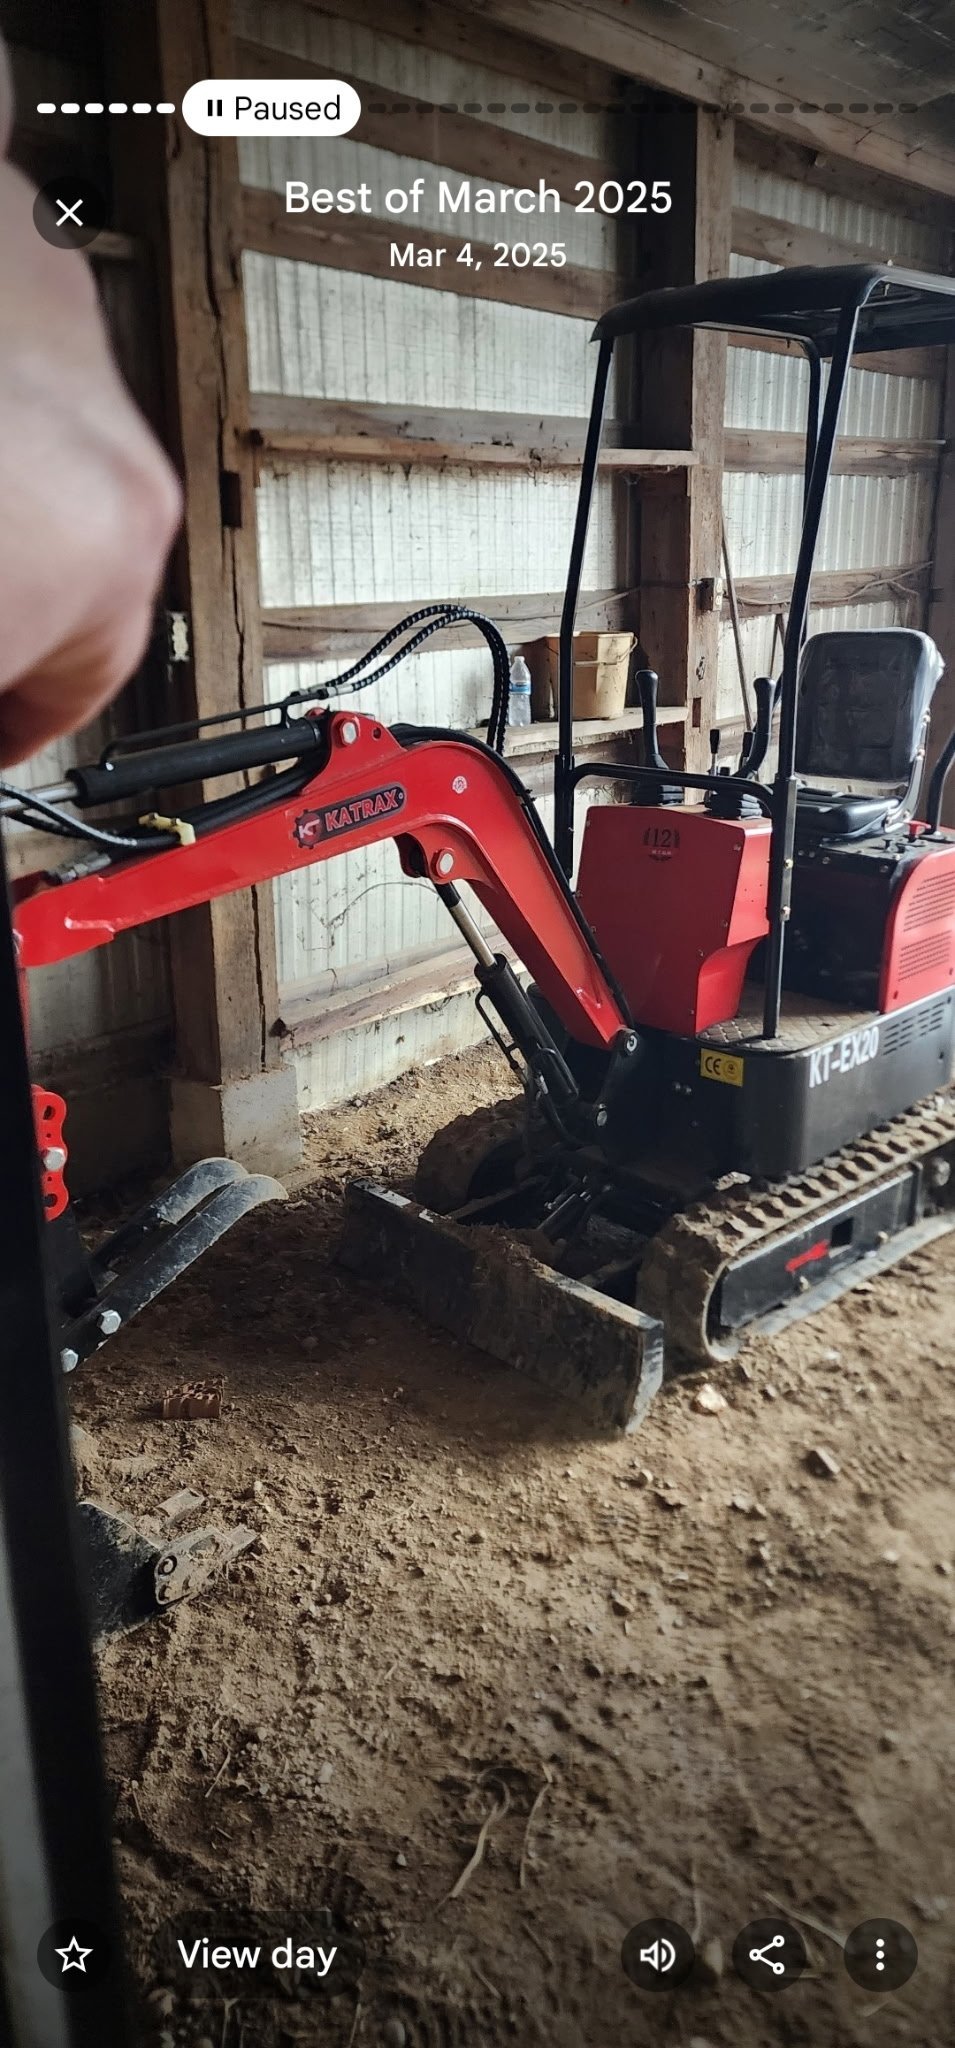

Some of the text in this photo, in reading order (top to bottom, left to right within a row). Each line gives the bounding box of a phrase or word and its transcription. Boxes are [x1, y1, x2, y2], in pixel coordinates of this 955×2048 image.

[325, 789, 398, 832] KATRAX
[705, 1056, 721, 1076] CE
[808, 1026, 879, 1089] KT-EX20
